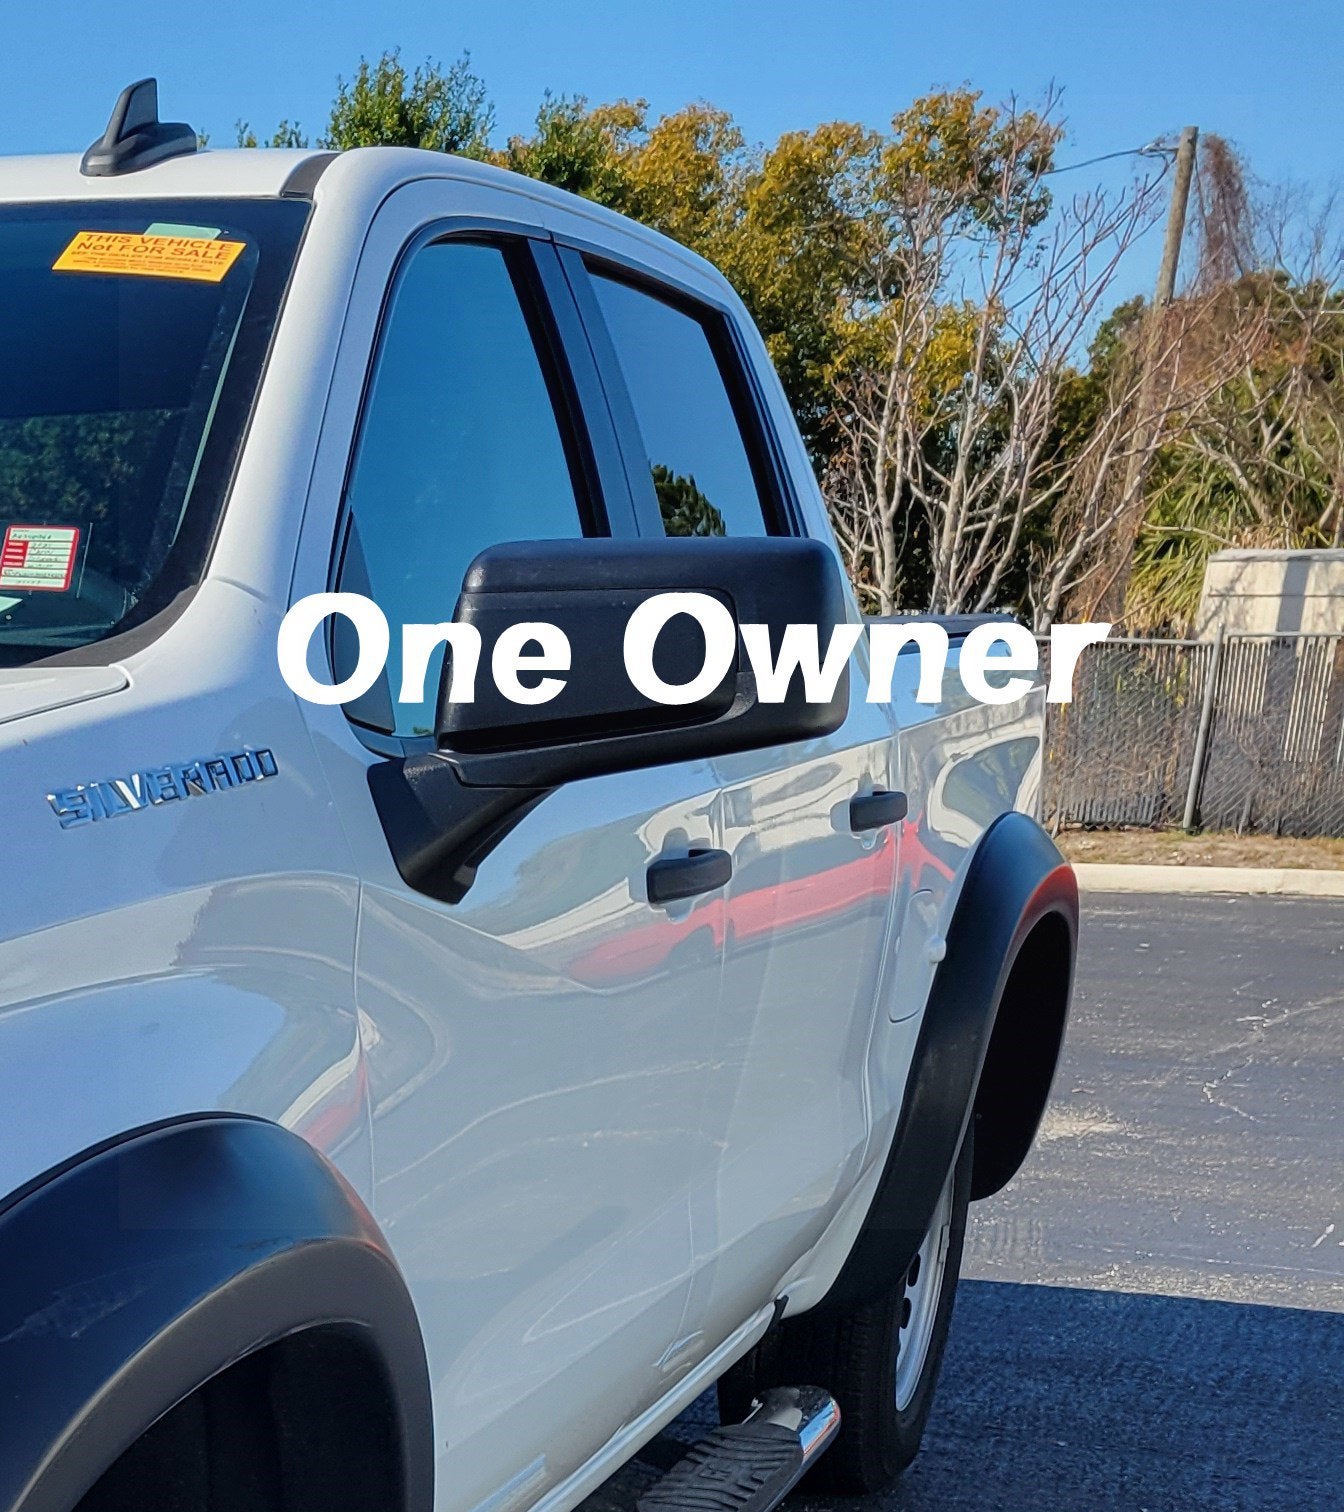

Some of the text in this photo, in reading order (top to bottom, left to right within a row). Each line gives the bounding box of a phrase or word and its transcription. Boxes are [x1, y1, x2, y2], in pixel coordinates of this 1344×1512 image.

[86, 234, 235, 252] THIS VEHICLE
[119, 244, 166, 255] FOR
[170, 247, 232, 261] SALE
[46, 748, 280, 830] SILVERADO
